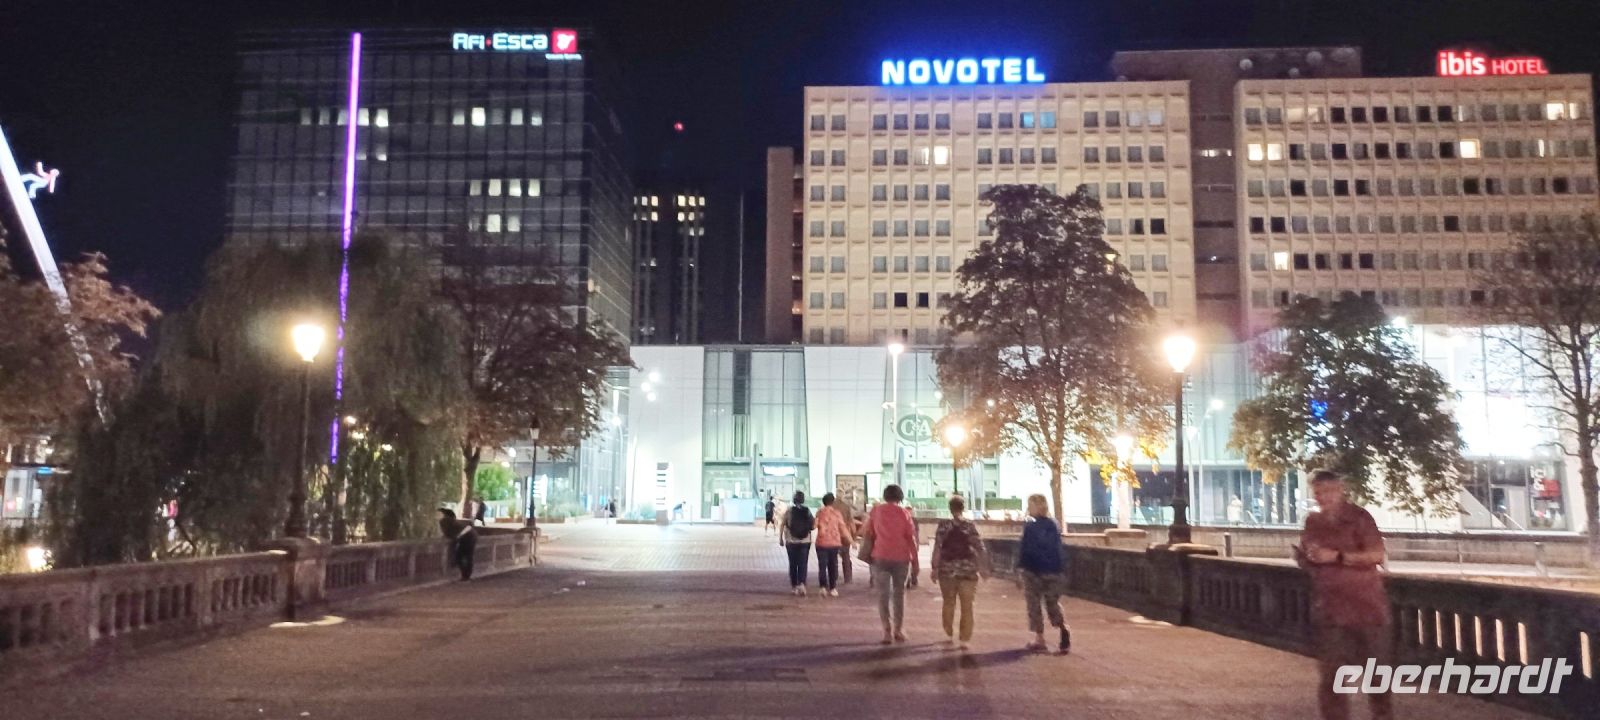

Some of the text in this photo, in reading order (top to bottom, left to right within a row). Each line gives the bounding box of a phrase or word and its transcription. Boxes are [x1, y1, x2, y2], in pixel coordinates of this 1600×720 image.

[881, 57, 1046, 85] NOVOTEL
[1439, 51, 1547, 76] ibis HOTEL
[900, 418, 932, 438] C&A
